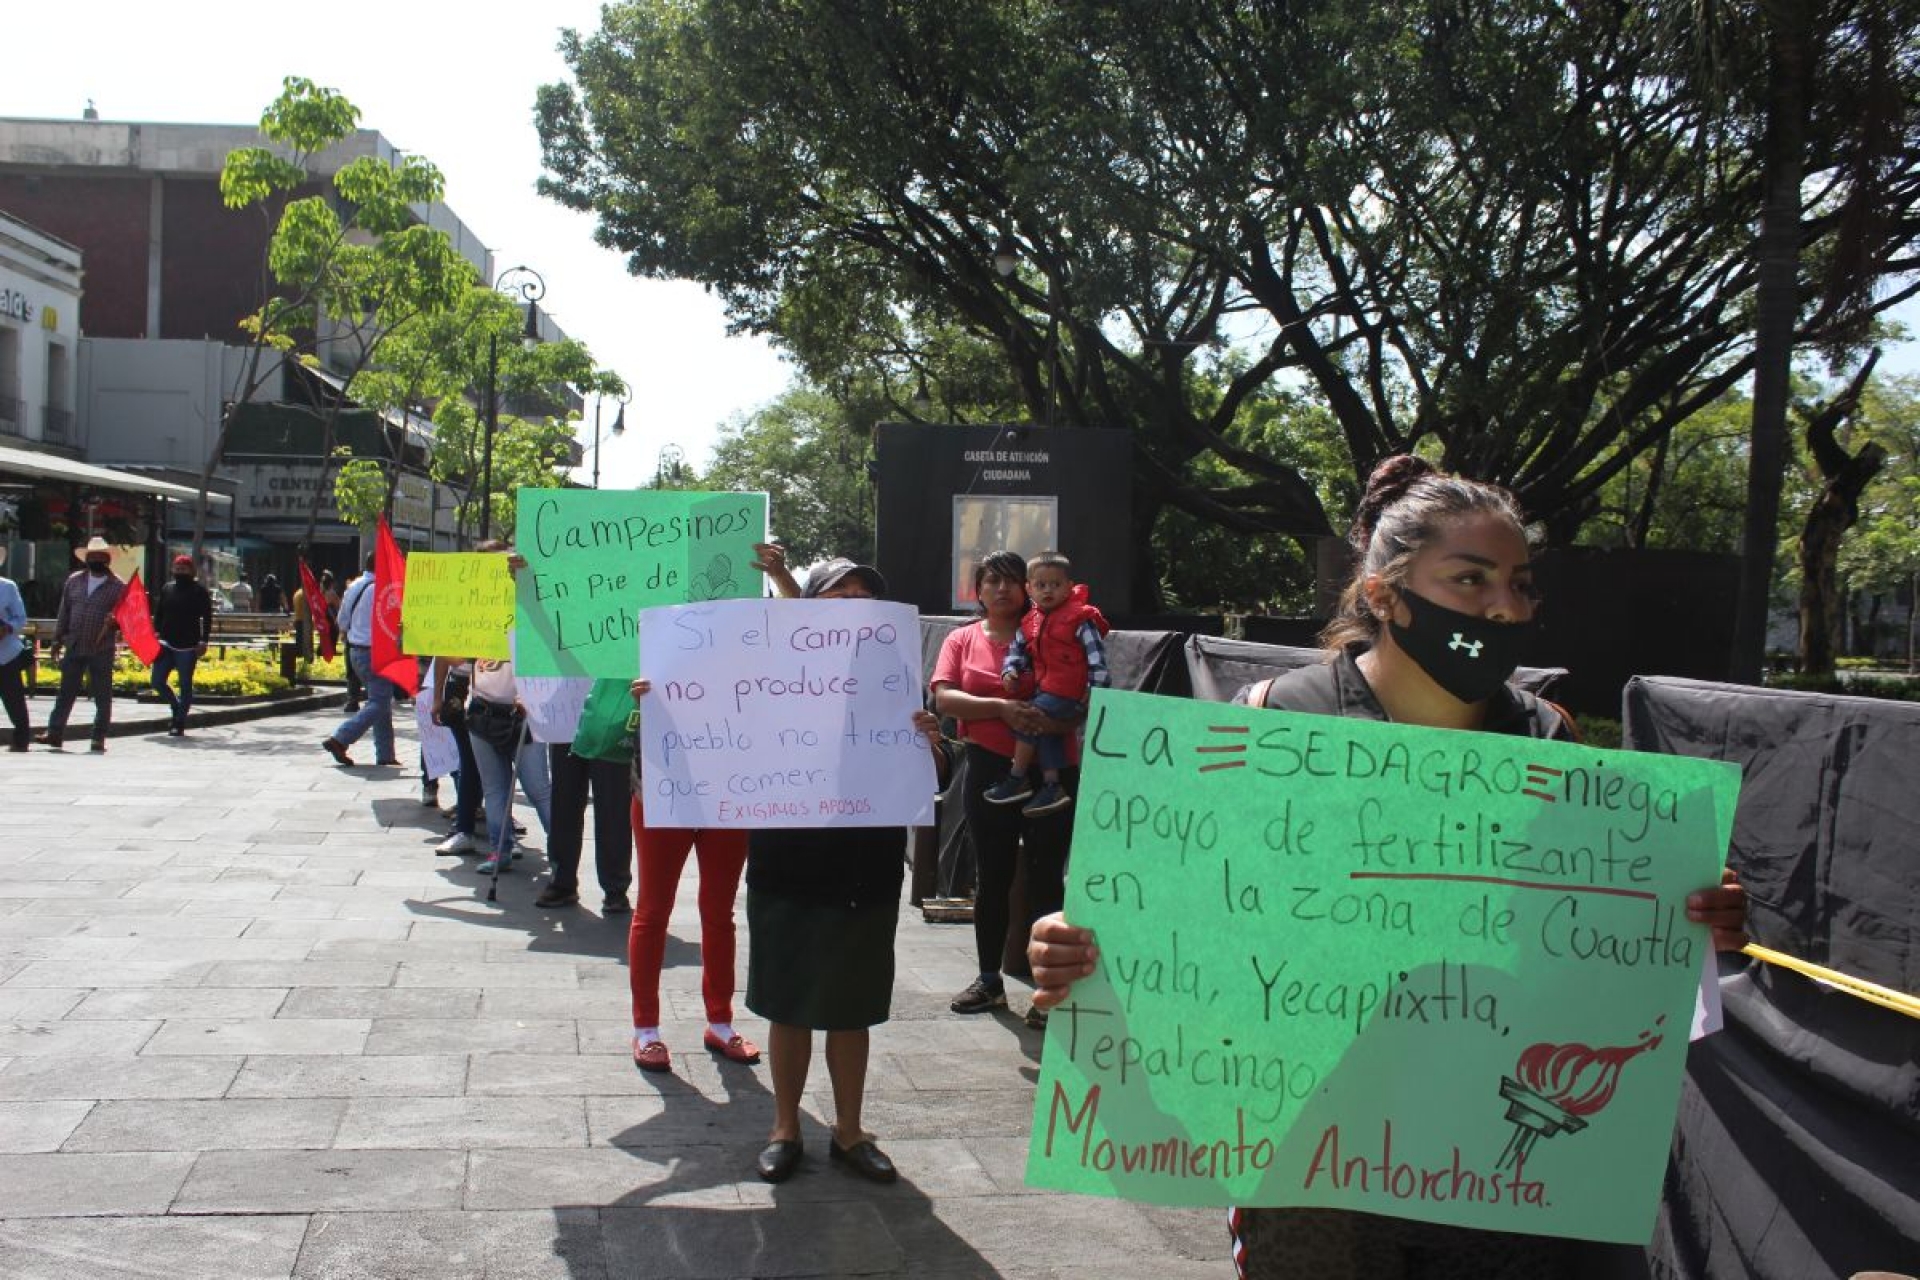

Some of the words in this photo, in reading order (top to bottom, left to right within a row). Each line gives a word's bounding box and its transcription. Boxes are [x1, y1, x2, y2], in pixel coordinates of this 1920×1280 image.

[964, 450, 995, 461] CASETA
[996, 450, 1008, 461] DE
[1009, 448, 1049, 463] ATENCIÓN
[983, 469, 1031, 481] CIUDADANA
[250, 496, 282, 508] LAS
[535, 498, 751, 558] Campesinos
[534, 573, 569, 601] En
[646, 562, 679, 590] de
[556, 607, 640, 651] Luch
[741, 608, 771, 649] el
[790, 623, 897, 658] campo
[665, 680, 705, 701] no
[734, 665, 859, 714] produce
[882, 664, 911, 696] el
[661, 717, 751, 769] pueblo
[778, 728, 819, 748] no
[658, 777, 712, 817] que
[727, 768, 827, 795] comer.
[1090, 705, 1174, 768] La
[1257, 727, 1521, 799] SEDAGRO
[1564, 758, 1678, 843] niega
[1092, 790, 1219, 866] apoyo
[1264, 799, 1315, 856] de
[1352, 798, 1652, 884] fertilizante
[1085, 871, 1145, 911] en
[1223, 857, 1264, 915] la
[1290, 886, 1415, 936] zona
[1458, 894, 1516, 945] de
[1541, 895, 1692, 968] Cuautla
[1101, 930, 1220, 1014] yala,
[1252, 956, 1511, 1037] Yecaplixtla,
[1055, 1001, 1329, 1124] Tepalcingo.
[1045, 1079, 1275, 1179] Movimiento
[1303, 1119, 1552, 1208] Antorchista.
